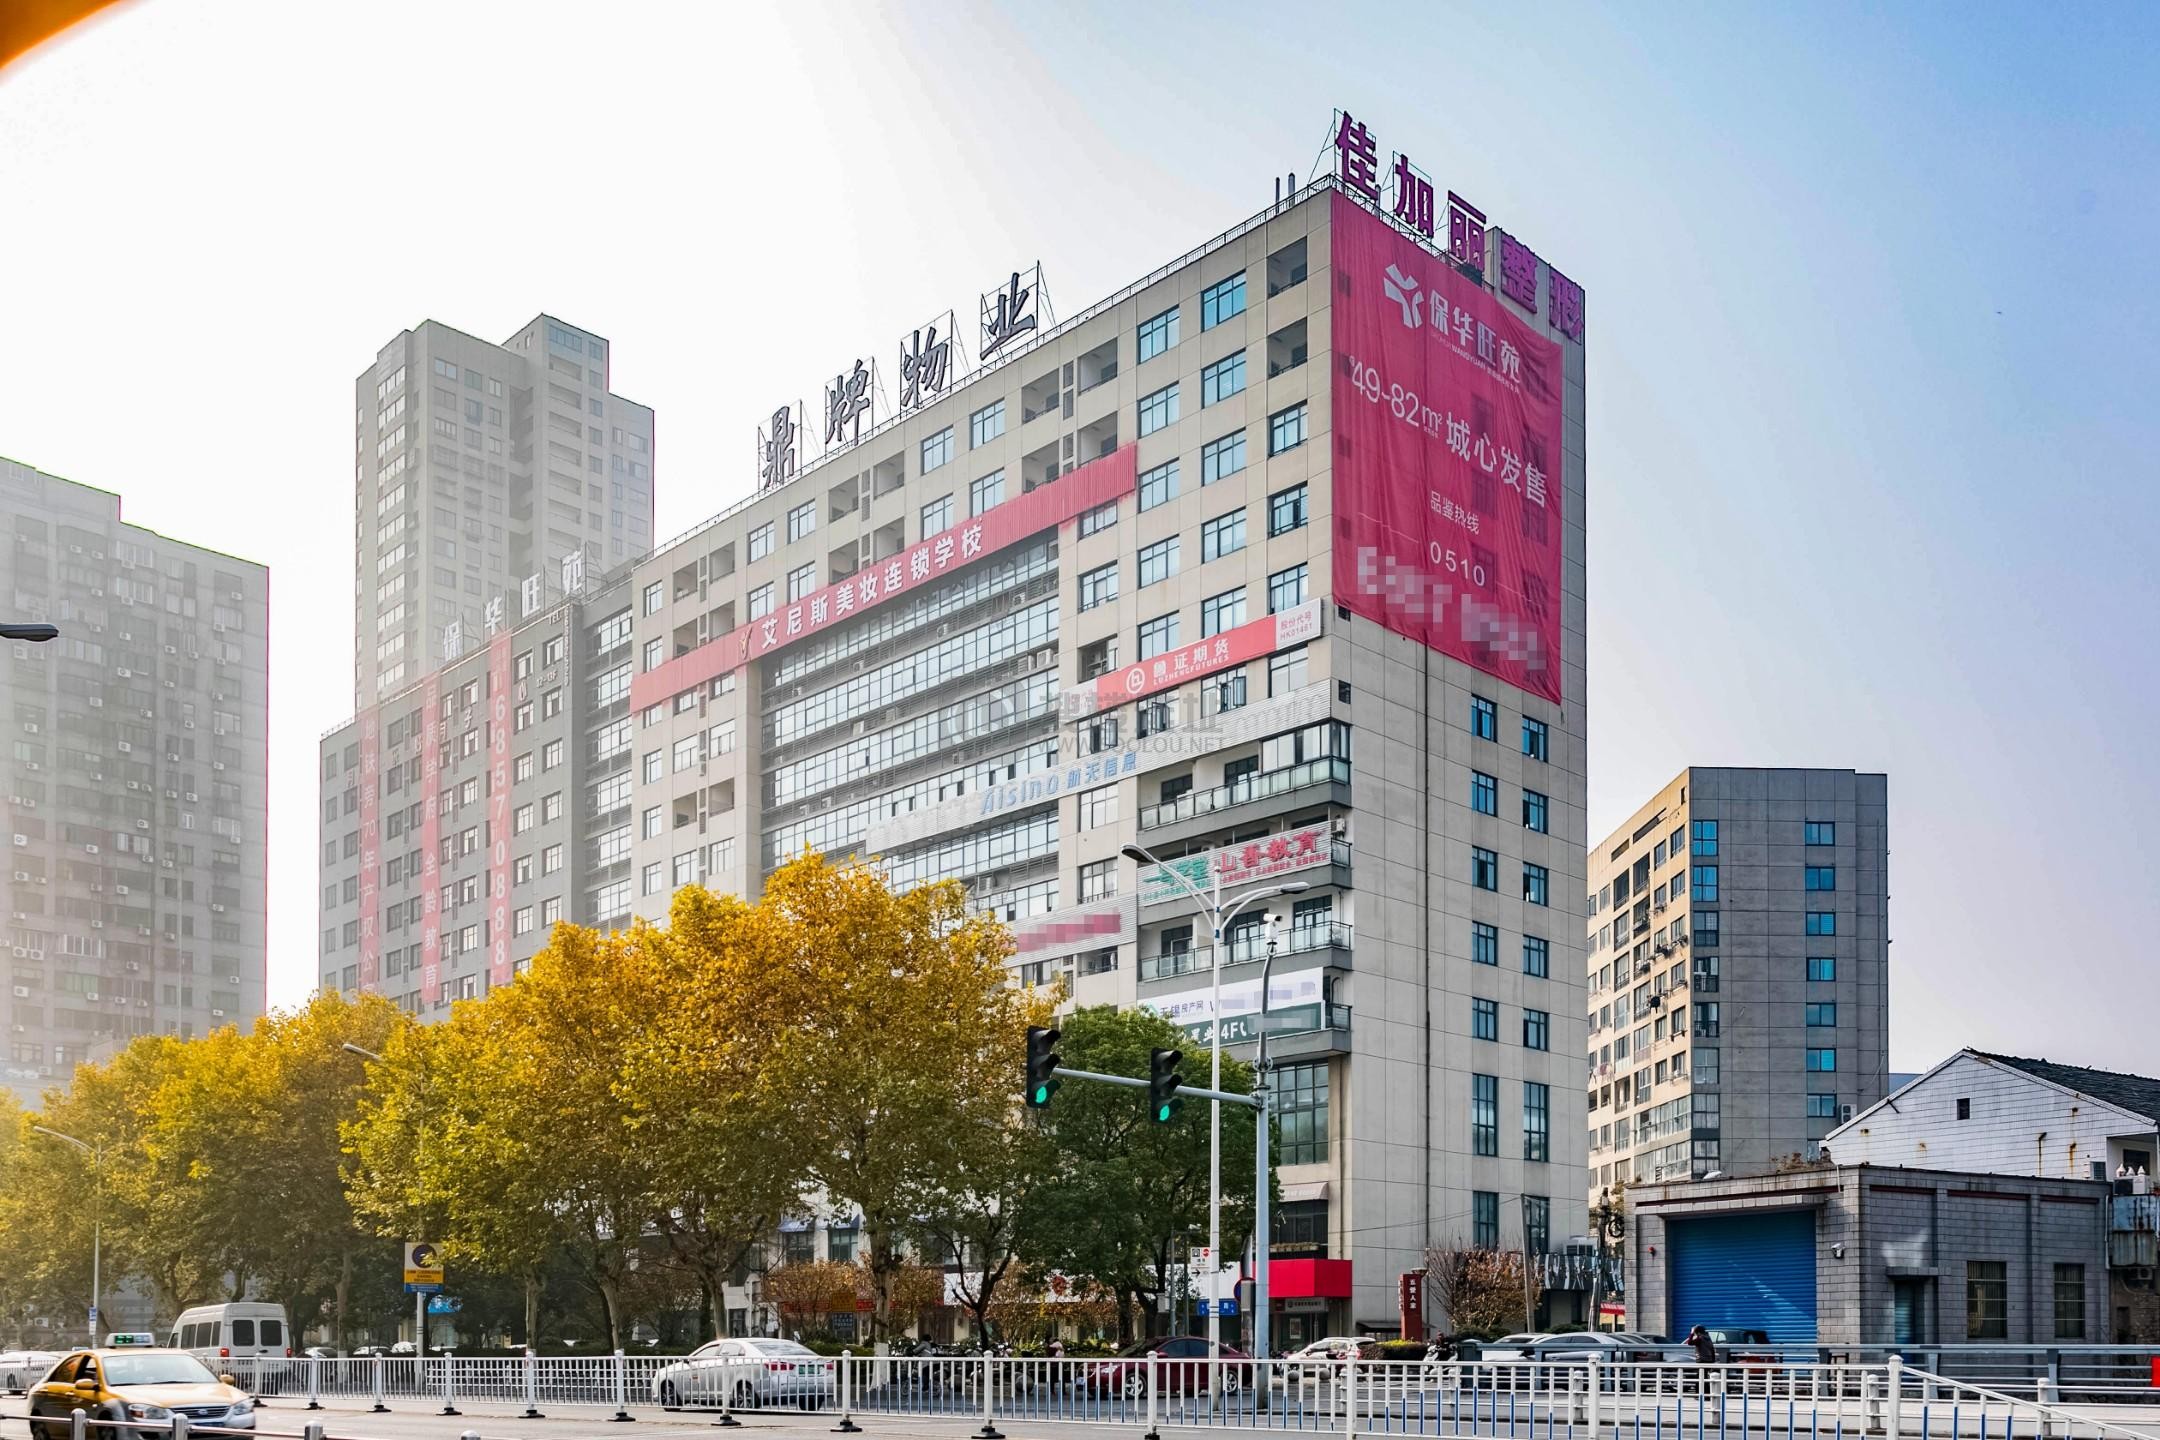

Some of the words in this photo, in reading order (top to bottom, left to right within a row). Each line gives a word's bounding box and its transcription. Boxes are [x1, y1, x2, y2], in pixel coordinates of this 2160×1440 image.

[762, 272, 1036, 488] 鼎牌物业
[1430, 290, 1520, 383] 保华旺苑
[1446, 412, 1547, 508] 城心发售
[1430, 490, 1480, 535] 品鉴热线
[761, 517, 983, 649] 艾尼斯美妆连锁学校
[1430, 541, 1485, 587] 0510
